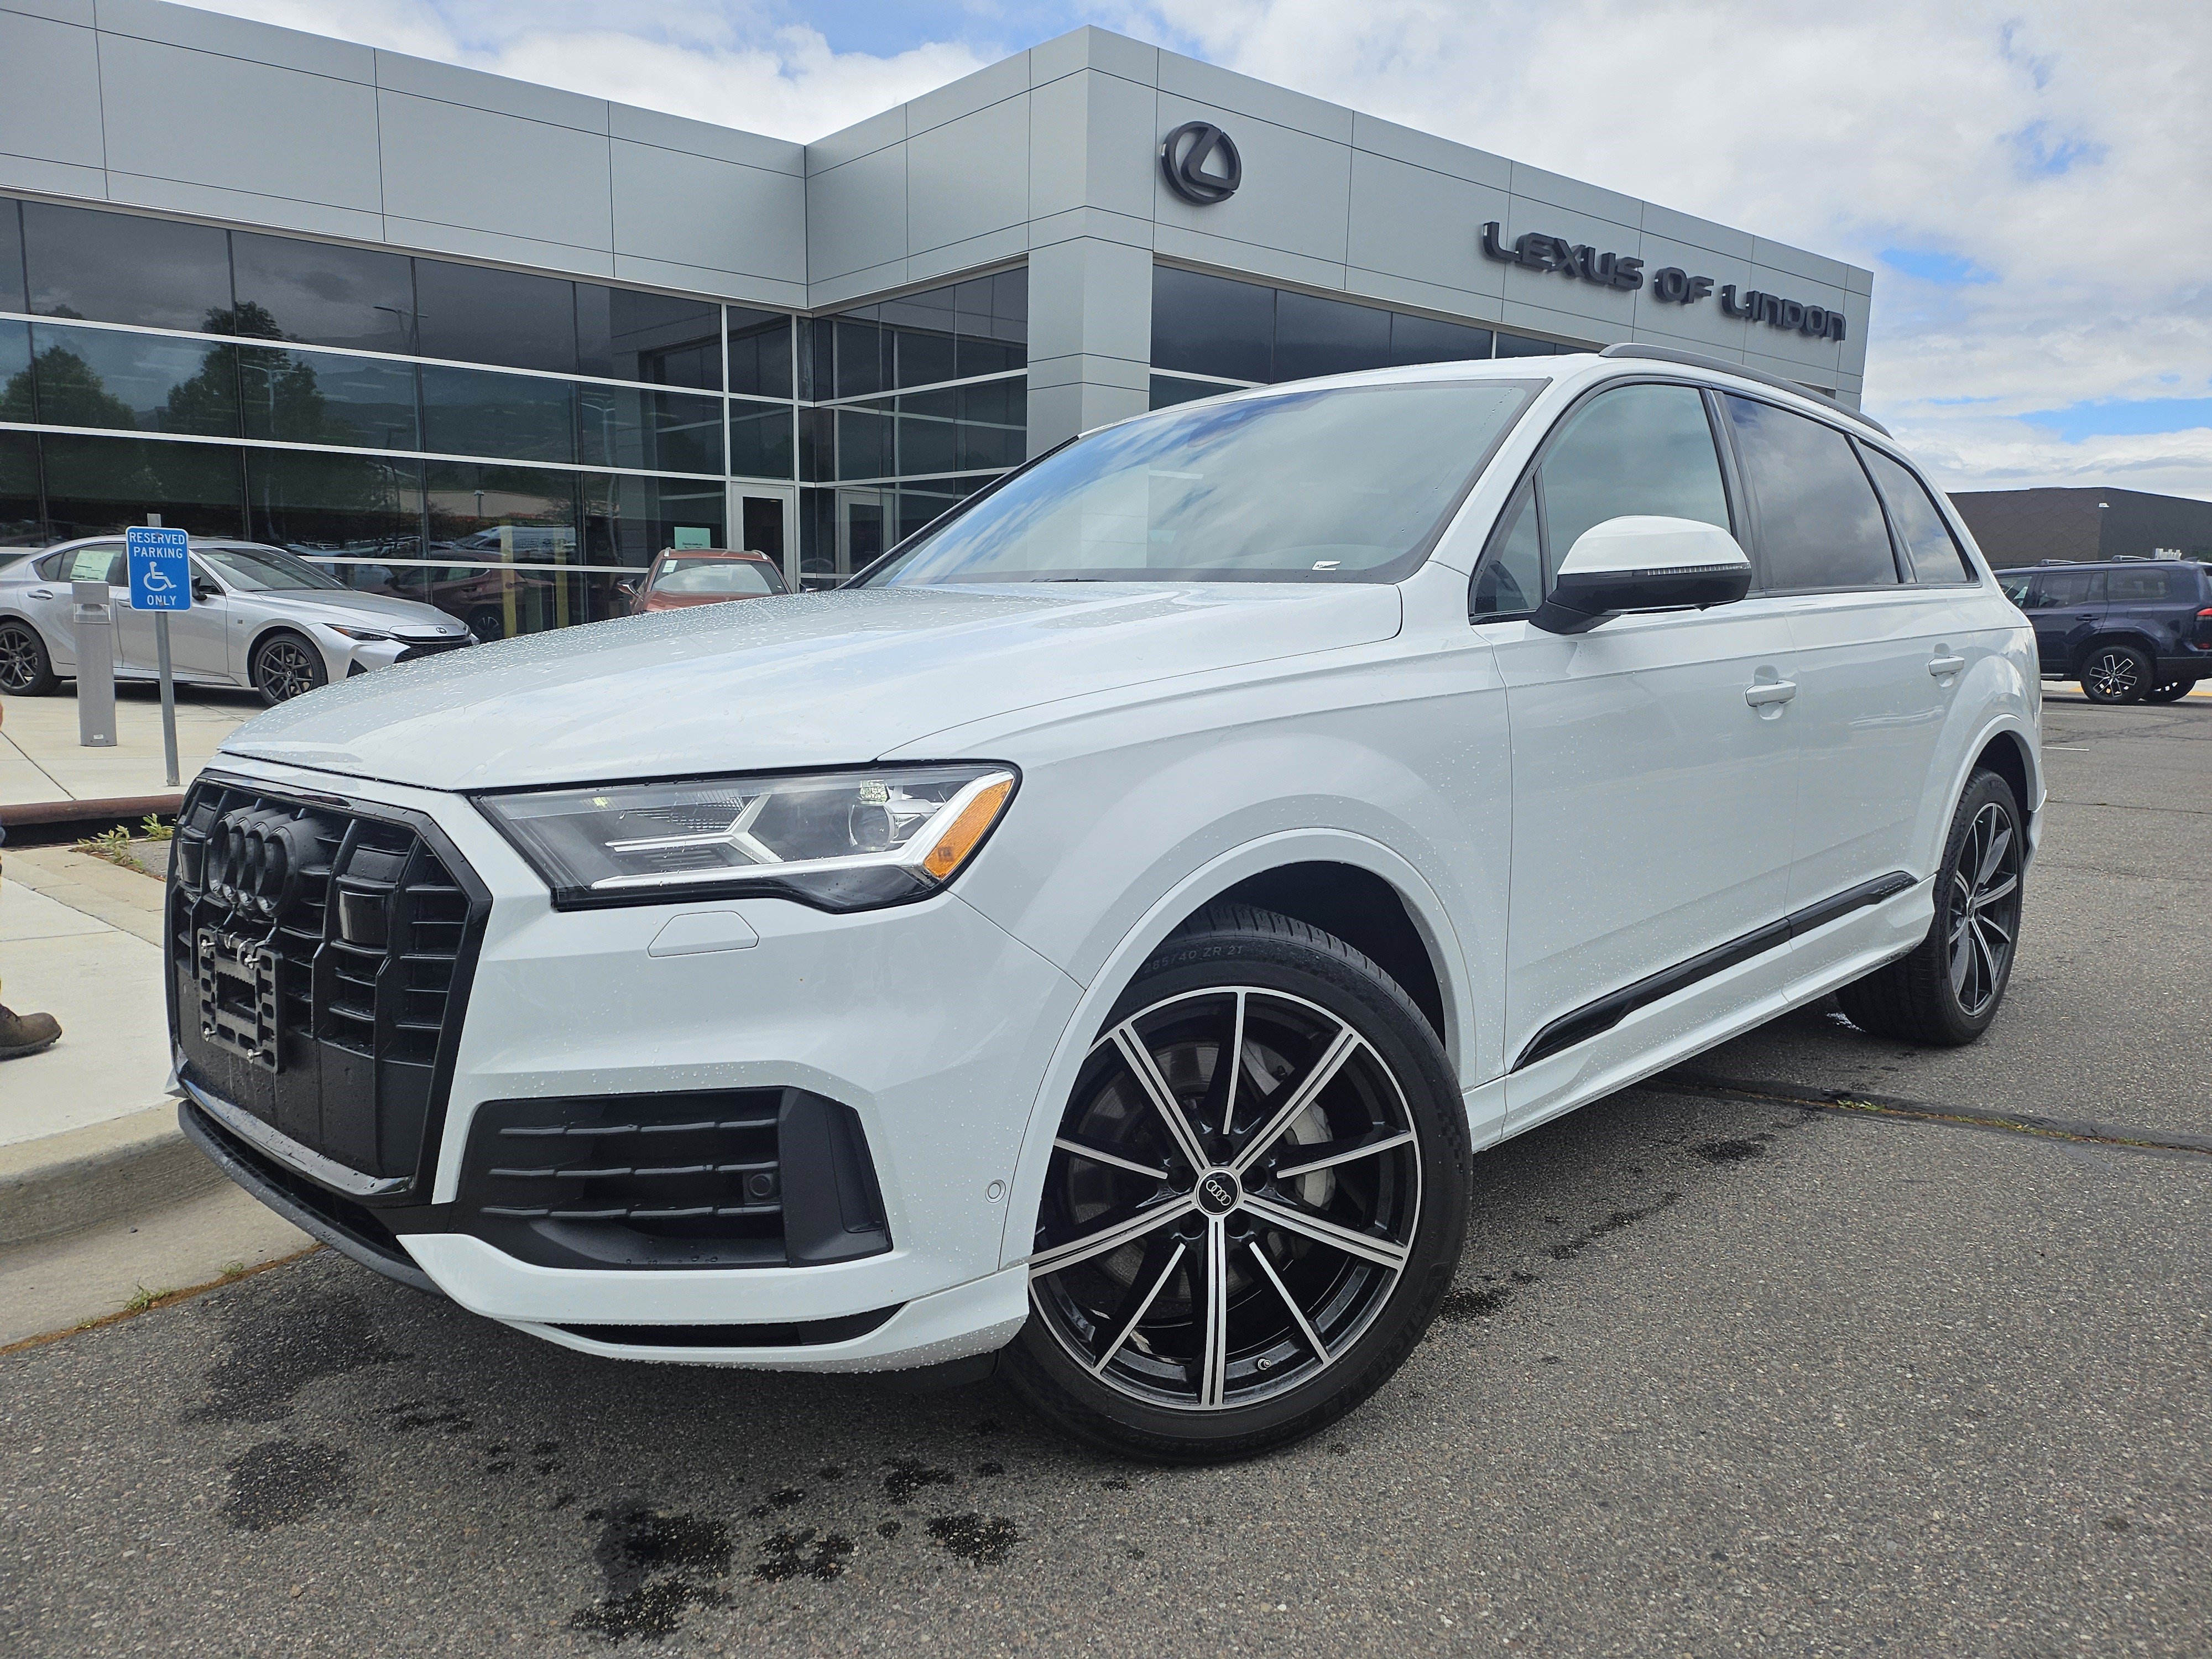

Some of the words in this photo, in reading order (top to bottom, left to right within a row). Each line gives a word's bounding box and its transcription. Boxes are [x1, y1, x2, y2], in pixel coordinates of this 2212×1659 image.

[1483, 221, 1644, 290] LEXUS
[1654, 267, 1714, 304] OF
[1721, 284, 1846, 341] LINDON
[129, 531, 185, 545] RESERVED
[133, 546, 183, 559] PARKING
[147, 594, 176, 606] ONLY
